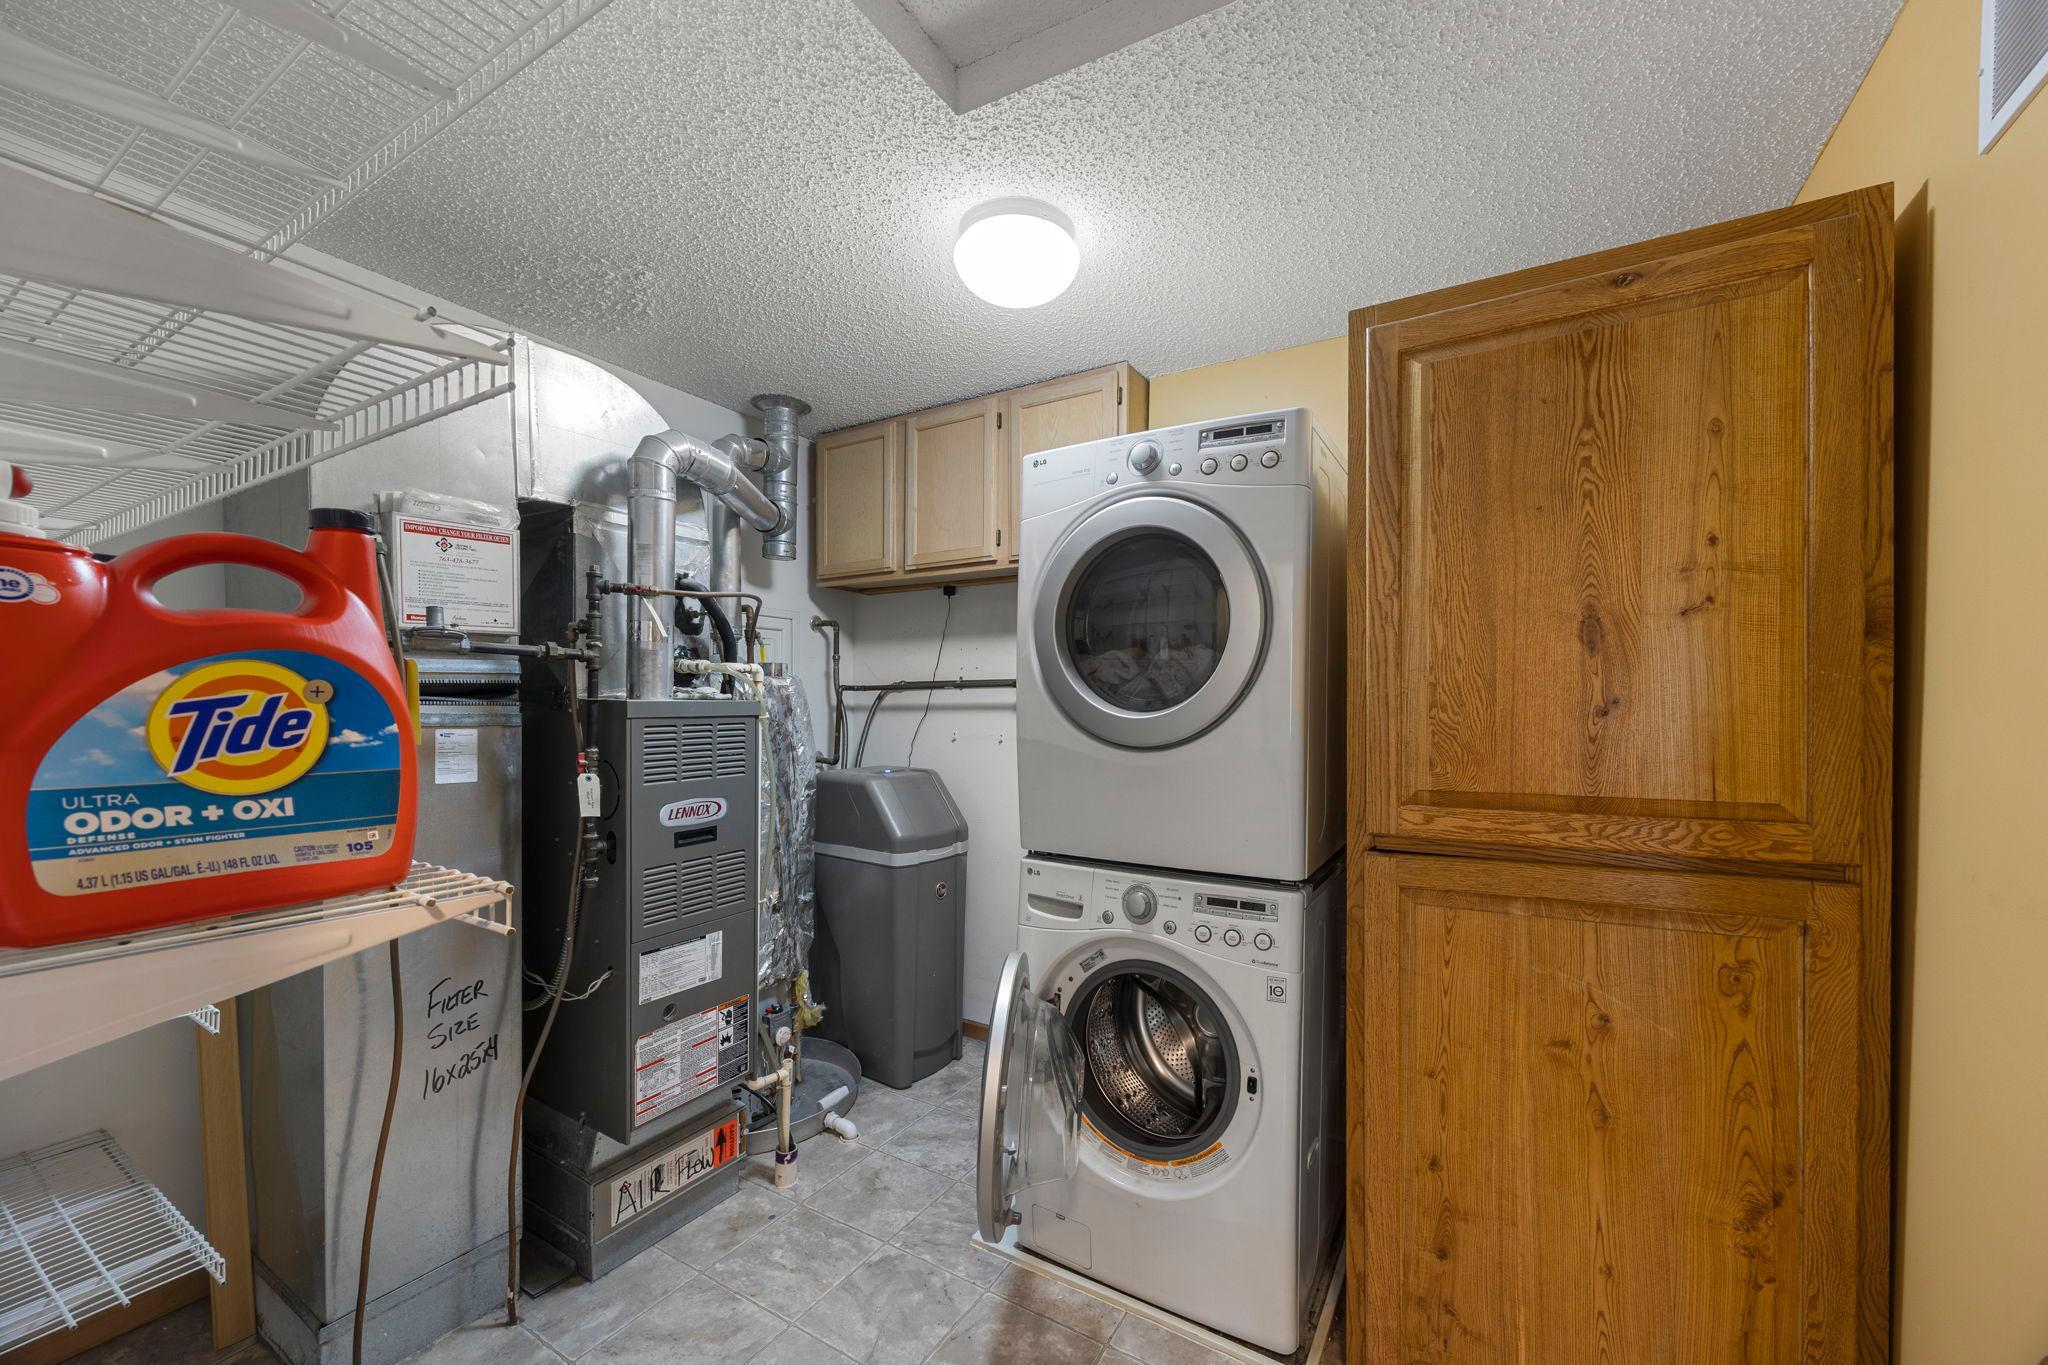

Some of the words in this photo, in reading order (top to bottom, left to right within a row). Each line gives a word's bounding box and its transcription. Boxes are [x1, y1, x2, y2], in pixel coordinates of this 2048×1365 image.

[405, 524, 438, 534] IMPORTANT:
[439, 528, 460, 536] CHANGE
[461, 531, 476, 539] YOUR
[476, 533, 493, 541] FILTER
[493, 535, 509, 543] OFTEN
[167, 693, 314, 775] Tide
[62, 793, 140, 810] ULTRA
[64, 805, 194, 835] ODOR
[202, 805, 224, 821] +
[233, 797, 295, 821] OXI
[668, 803, 711, 821] LENNOX
[67, 832, 136, 845] DEFENSE
[68, 844, 130, 856] ADVANCED
[132, 840, 163, 850] ODOR
[174, 836, 203, 845] STAIN
[206, 832, 246, 841] FIGHTER
[346, 841, 374, 852] 105
[76, 876, 98, 890] 4.37
[101, 874, 107, 887] L
[111, 872, 134, 888] (1.15
[135, 870, 149, 882] US
[151, 863, 195, 879] GAL/GAL.
[222, 858, 238, 870] 148
[240, 857, 248, 868] FL
[252, 855, 262, 867] OZ
[264, 854, 280, 865] LIQ.
[427, 977, 489, 1018] FILTER
[427, 1012, 480, 1049] SIZE
[616, 1164, 671, 1224] AIR
[676, 1147, 715, 1187] FLOW
